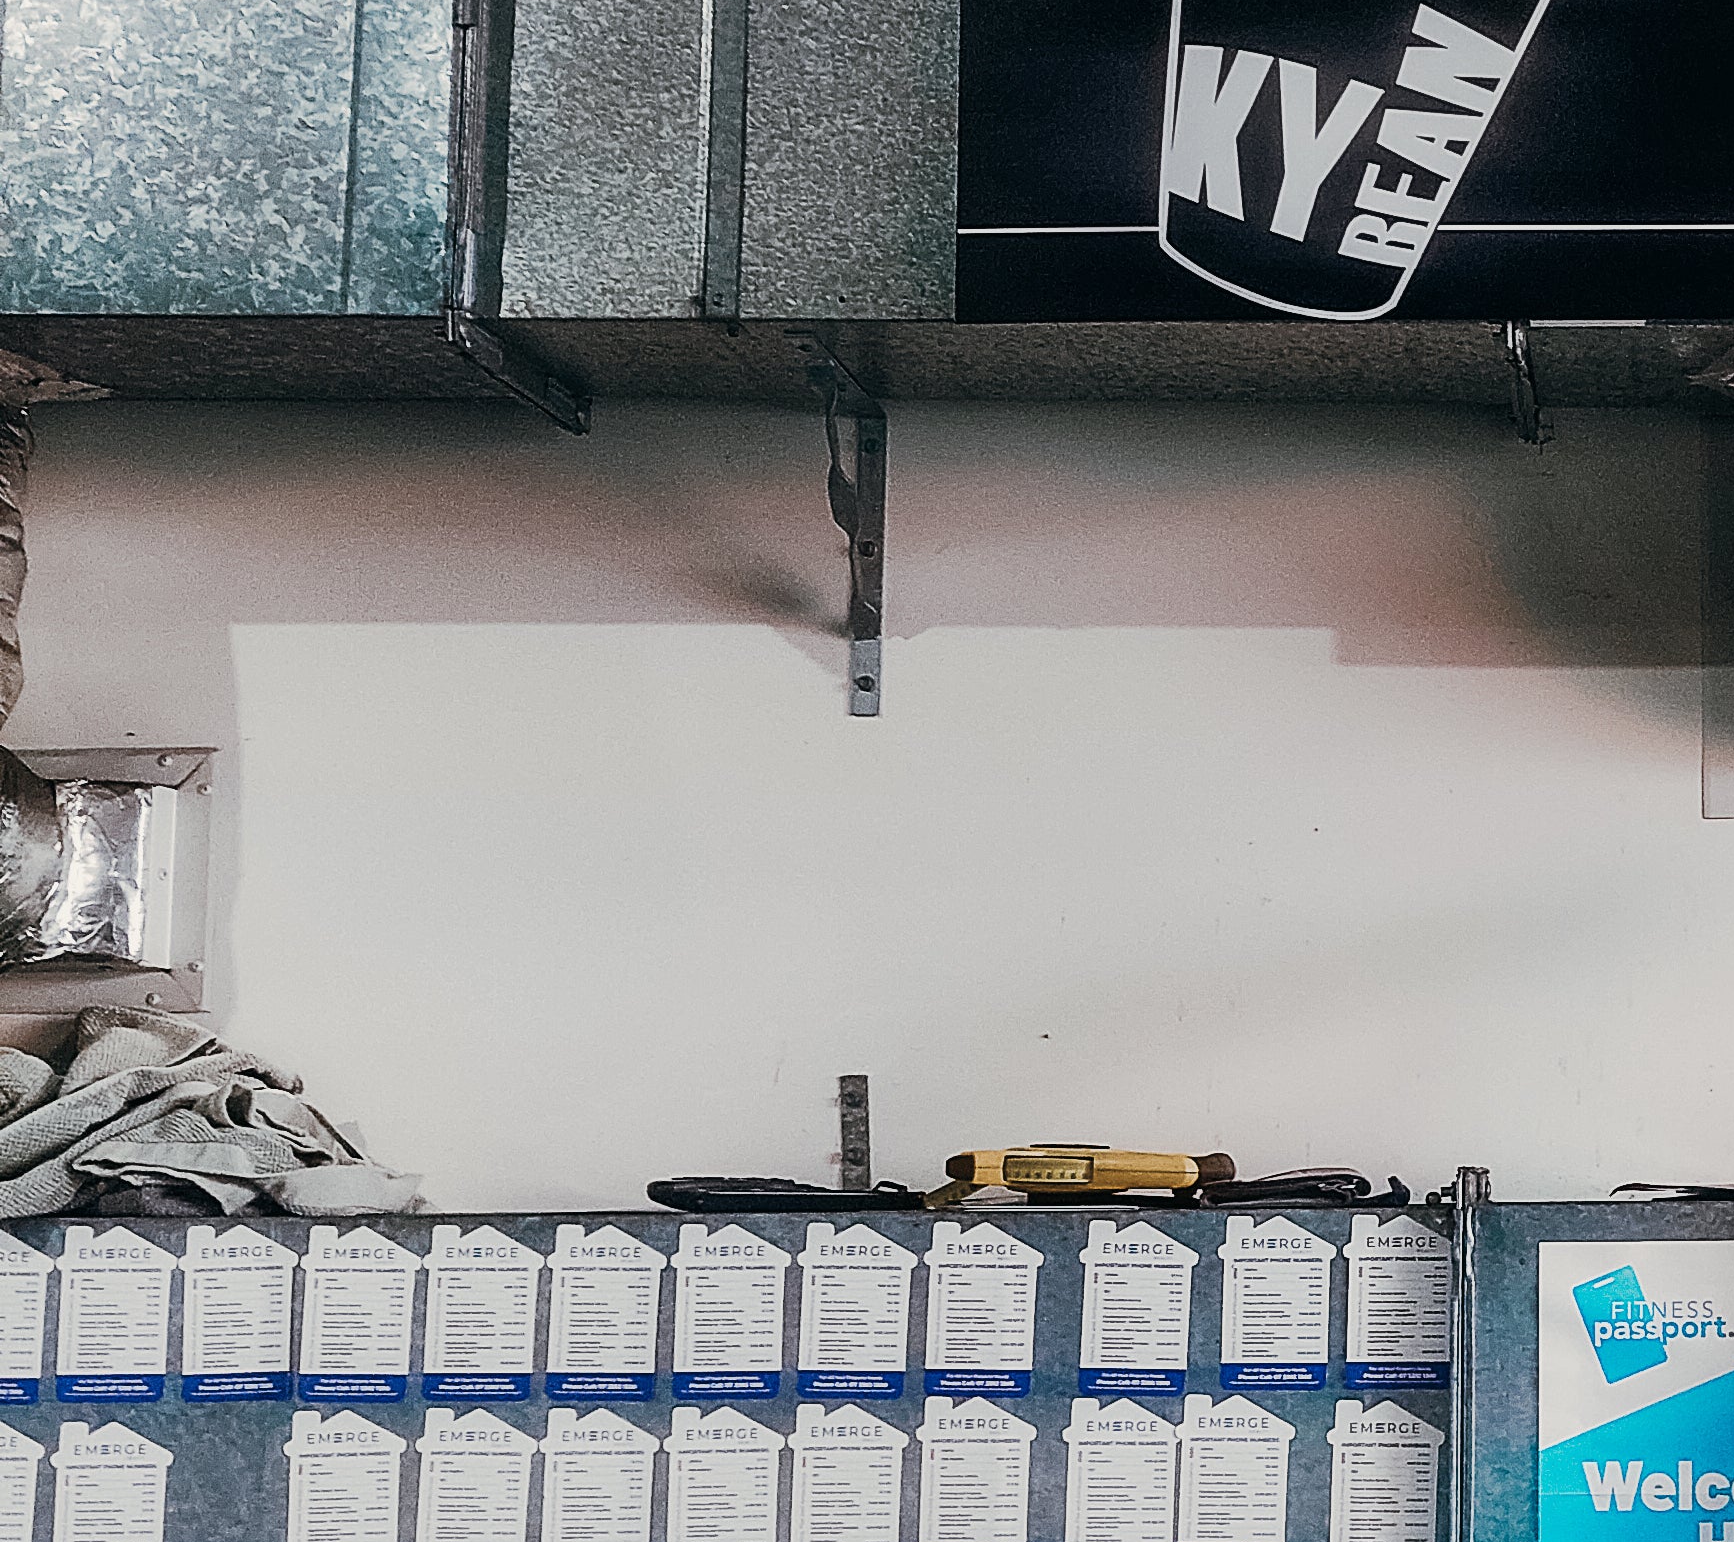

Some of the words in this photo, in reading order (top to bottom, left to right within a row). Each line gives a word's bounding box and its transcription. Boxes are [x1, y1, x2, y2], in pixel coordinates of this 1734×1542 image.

[1162, 44, 1384, 242] KY
[1102, 1242, 1174, 1255] EMERGE
[1241, 1237, 1312, 1250] EMERGE
[1366, 1236, 1438, 1248] EMERGE
[445, 1247, 519, 1258] EMERGE
[570, 1246, 642, 1259] EMERGE
[693, 1245, 765, 1258] EMERGE
[820, 1245, 892, 1257] EMERGE
[946, 1243, 1019, 1256] EMERGE
[1611, 1300, 1714, 1320] FITNESS
[1594, 1317, 1734, 1347] passport.
[938, 1418, 1010, 1430] EMERGE
[1086, 1420, 1158, 1432] EMERGE
[1198, 1417, 1269, 1429] EMERGE
[1349, 1422, 1422, 1435] EMERGE
[306, 1431, 380, 1445] EMERGE
[439, 1430, 512, 1443] EMERGE
[562, 1429, 634, 1442] EMERGE
[686, 1427, 758, 1441] EMERGE
[810, 1425, 883, 1438] EMERGE
[74, 1443, 147, 1456] EMERGE
